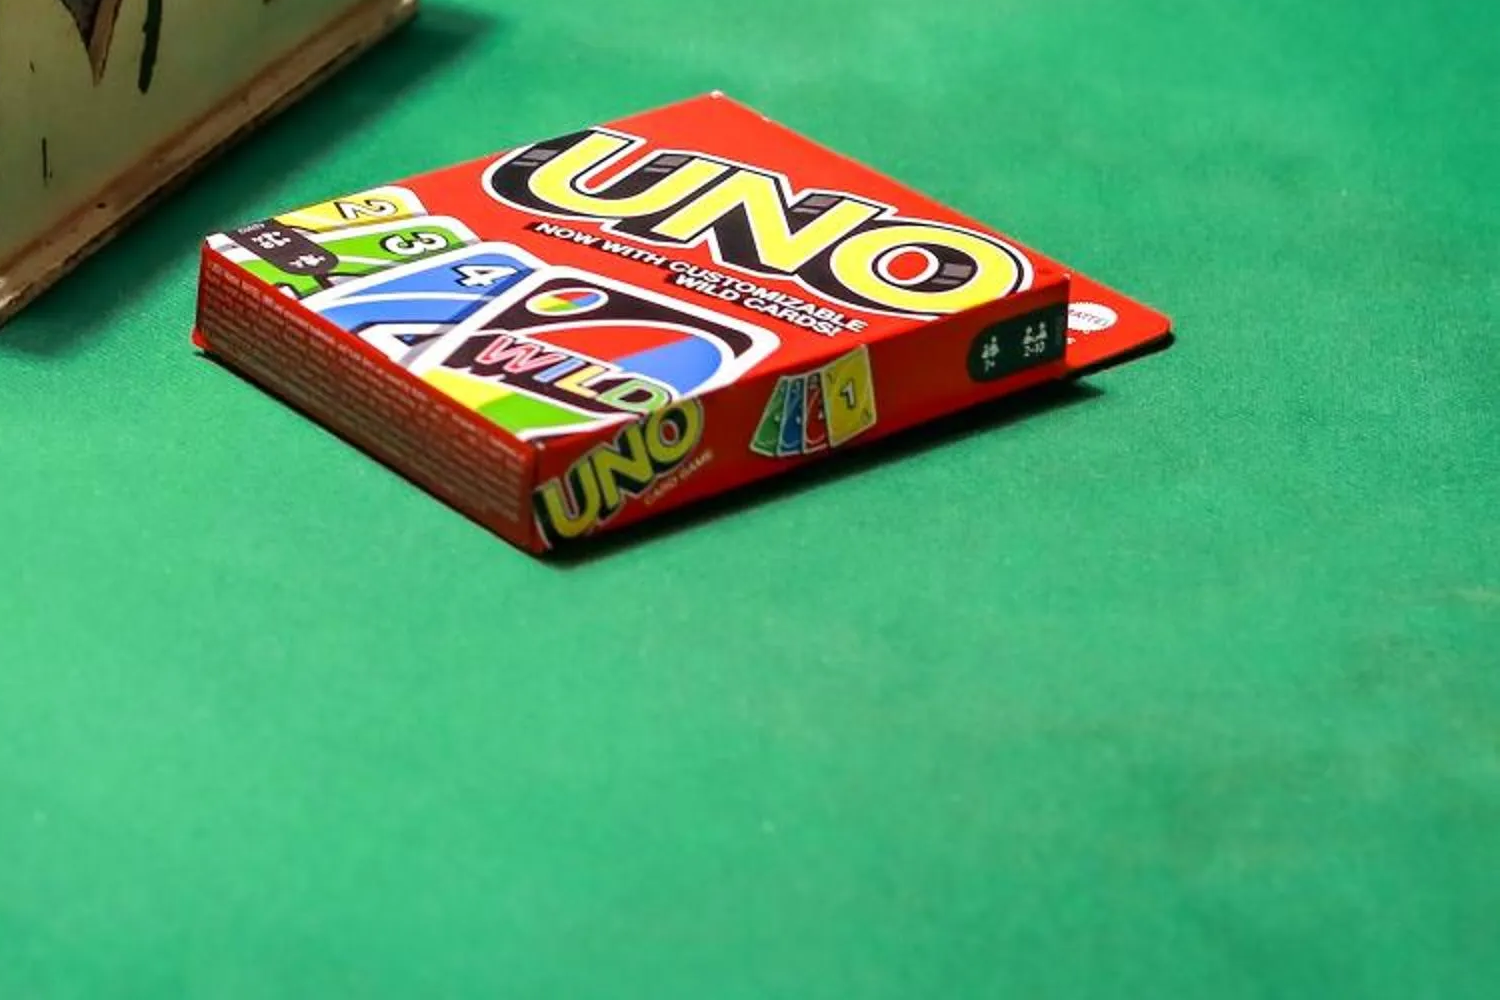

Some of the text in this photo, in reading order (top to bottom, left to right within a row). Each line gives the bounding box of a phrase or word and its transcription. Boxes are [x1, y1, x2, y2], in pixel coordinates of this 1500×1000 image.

[337, 199, 398, 220] 2
[381, 231, 451, 256] 3
[488, 128, 1027, 316] UNO
[451, 264, 518, 288] 4
[535, 223, 868, 332] NOW WITH CUSTOMIZABLE
[675, 274, 843, 337] WILD CARDS!
[474, 335, 671, 413] WILD
[536, 399, 701, 539] UNO
